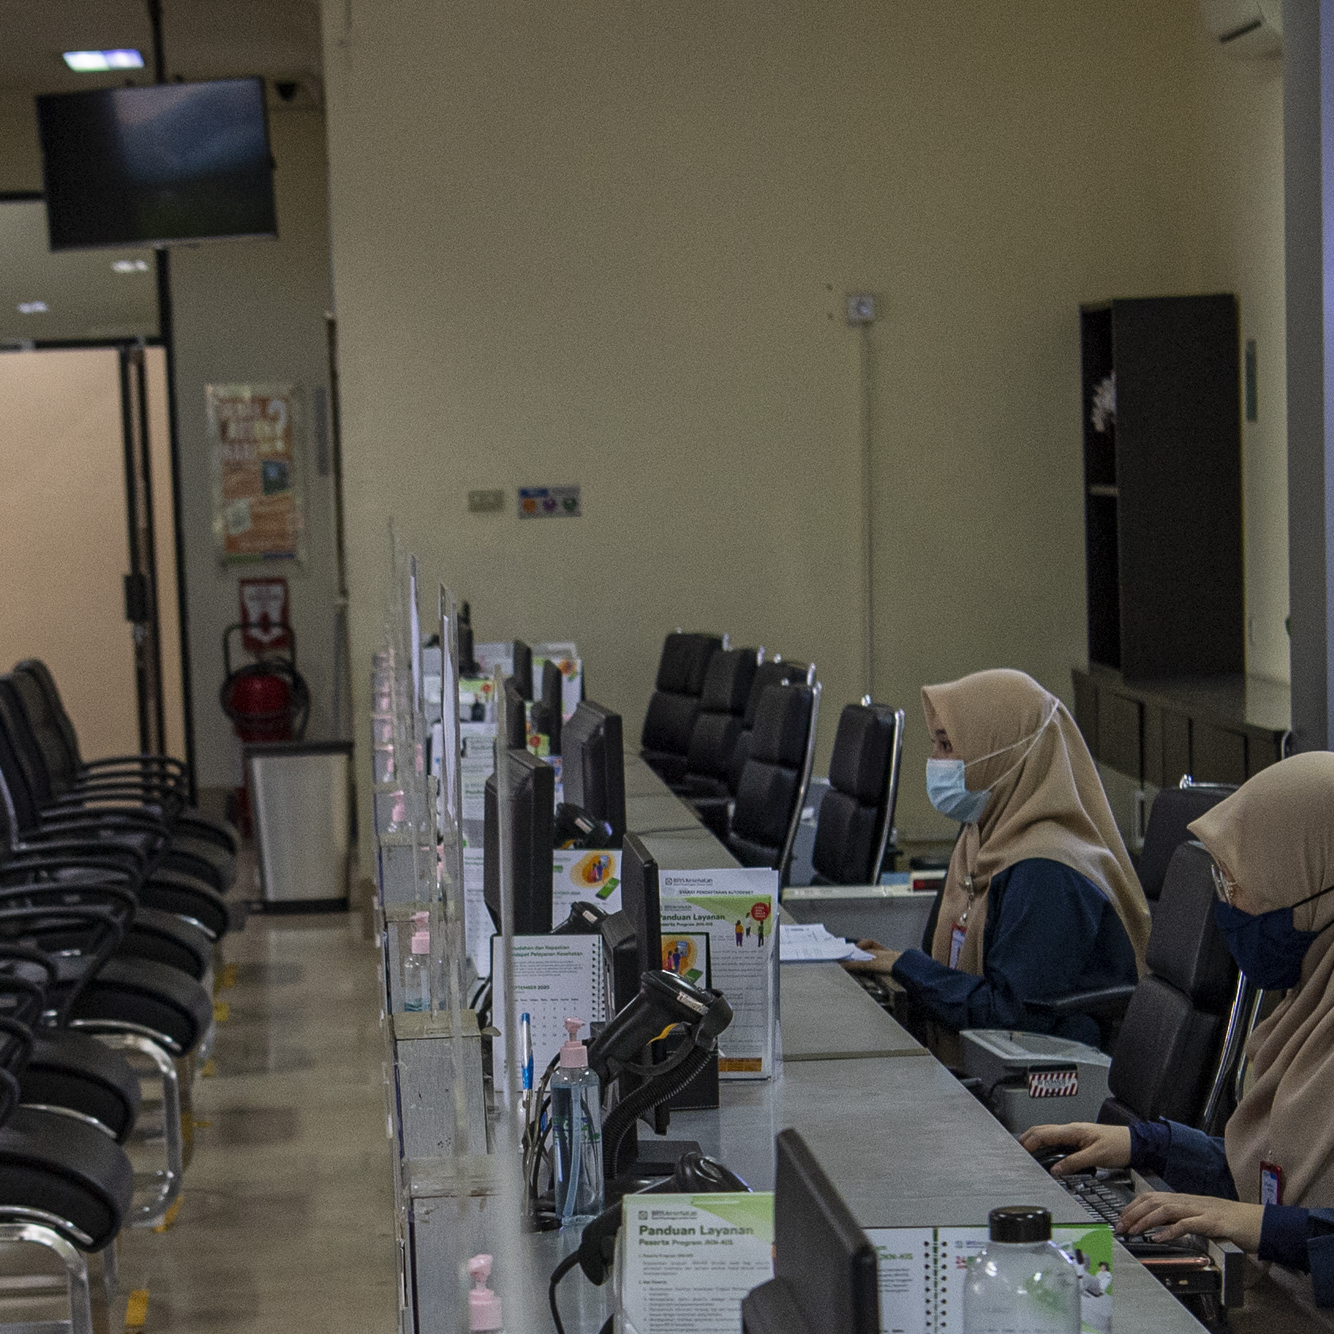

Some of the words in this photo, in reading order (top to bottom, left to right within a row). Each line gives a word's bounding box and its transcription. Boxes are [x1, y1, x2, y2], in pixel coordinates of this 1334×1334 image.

[693, 914, 726, 922] Layanan
[639, 1225, 696, 1236] Panduan
[700, 1225, 754, 1237] Layanan
[672, 1239, 703, 1247] Program
